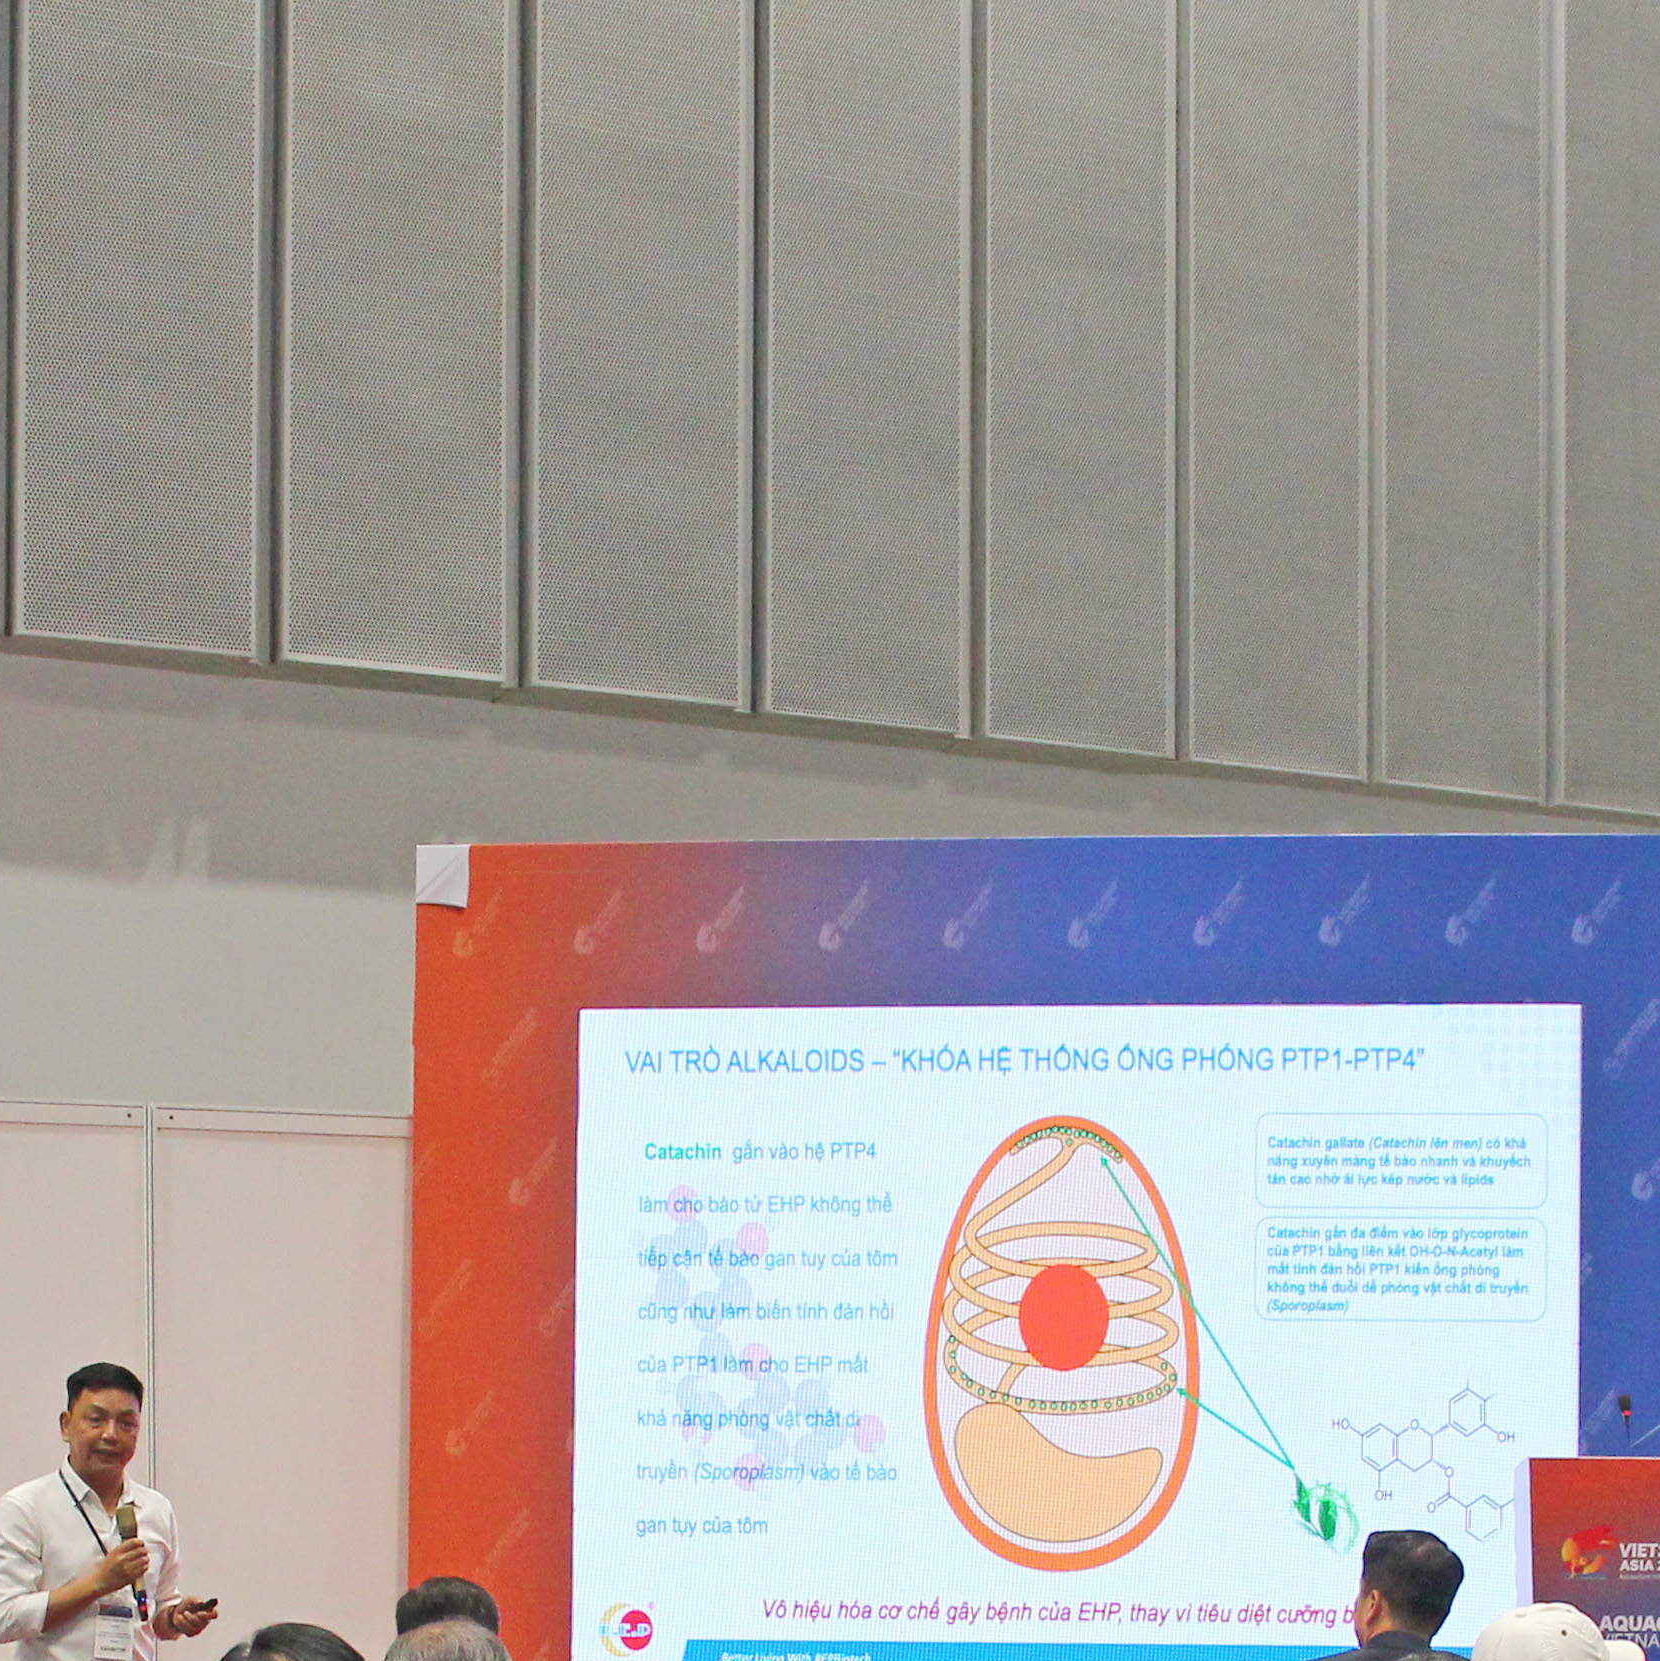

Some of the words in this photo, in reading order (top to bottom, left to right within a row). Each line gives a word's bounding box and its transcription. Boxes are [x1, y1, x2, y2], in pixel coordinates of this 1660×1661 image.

[626, 1050, 662, 1073] VAI
[669, 1044, 721, 1073] TRÒ
[727, 1050, 865, 1073] ALKALOIDS
[979, 1046, 1013, 1076] HỆ
[644, 1142, 722, 1160] Catachin
[768, 1141, 799, 1160] vào
[830, 1142, 877, 1160] PTP4
[1268, 1136, 1321, 1149] Catachin
[1325, 1136, 1366, 1152] gallate
[1421, 1155, 1458, 1167] nhanh
[1461, 1173, 1495, 1187] lipids
[673, 1194, 703, 1213] cho
[768, 1195, 807, 1213] EHP
[810, 1194, 861, 1217] không
[1268, 1226, 1321, 1240] Catachin
[1452, 1226, 1529, 1242] glycoprotein
[765, 1253, 796, 1272] gan
[867, 1249, 899, 1268] tôm
[1292, 1245, 1324, 1257] PTP1
[1369, 1263, 1400, 1275] PTP1
[672, 1355, 717, 1374] PTP1
[759, 1355, 790, 1374] cho
[795, 1355, 833, 1373] EHP
[672, 1409, 713, 1432] năng
[694, 1461, 806, 1485] (Sporoplasm)
[810, 1462, 841, 1481] vào
[636, 1519, 667, 1538] gan
[737, 1516, 769, 1534] tôm
[1619, 1560, 1655, 1572] ASIA
[763, 1599, 787, 1619] Vô
[792, 1598, 832, 1622] hiệu
[837, 1598, 871, 1619] hóa
[878, 1604, 902, 1620] cơ
[906, 1596, 941, 1620] chế
[946, 1602, 981, 1626] gây
[985, 1601, 1032, 1626] bệnh
[1038, 1599, 1072, 1622] của
[1078, 1602, 1123, 1625] EHP,
[1129, 1602, 1169, 1627] thay
[1175, 1601, 1193, 1622] vì
[1197, 1602, 1231, 1623] tiêu
[1237, 1601, 1273, 1627] diệt
[1276, 1602, 1336, 1628] cưỡng
